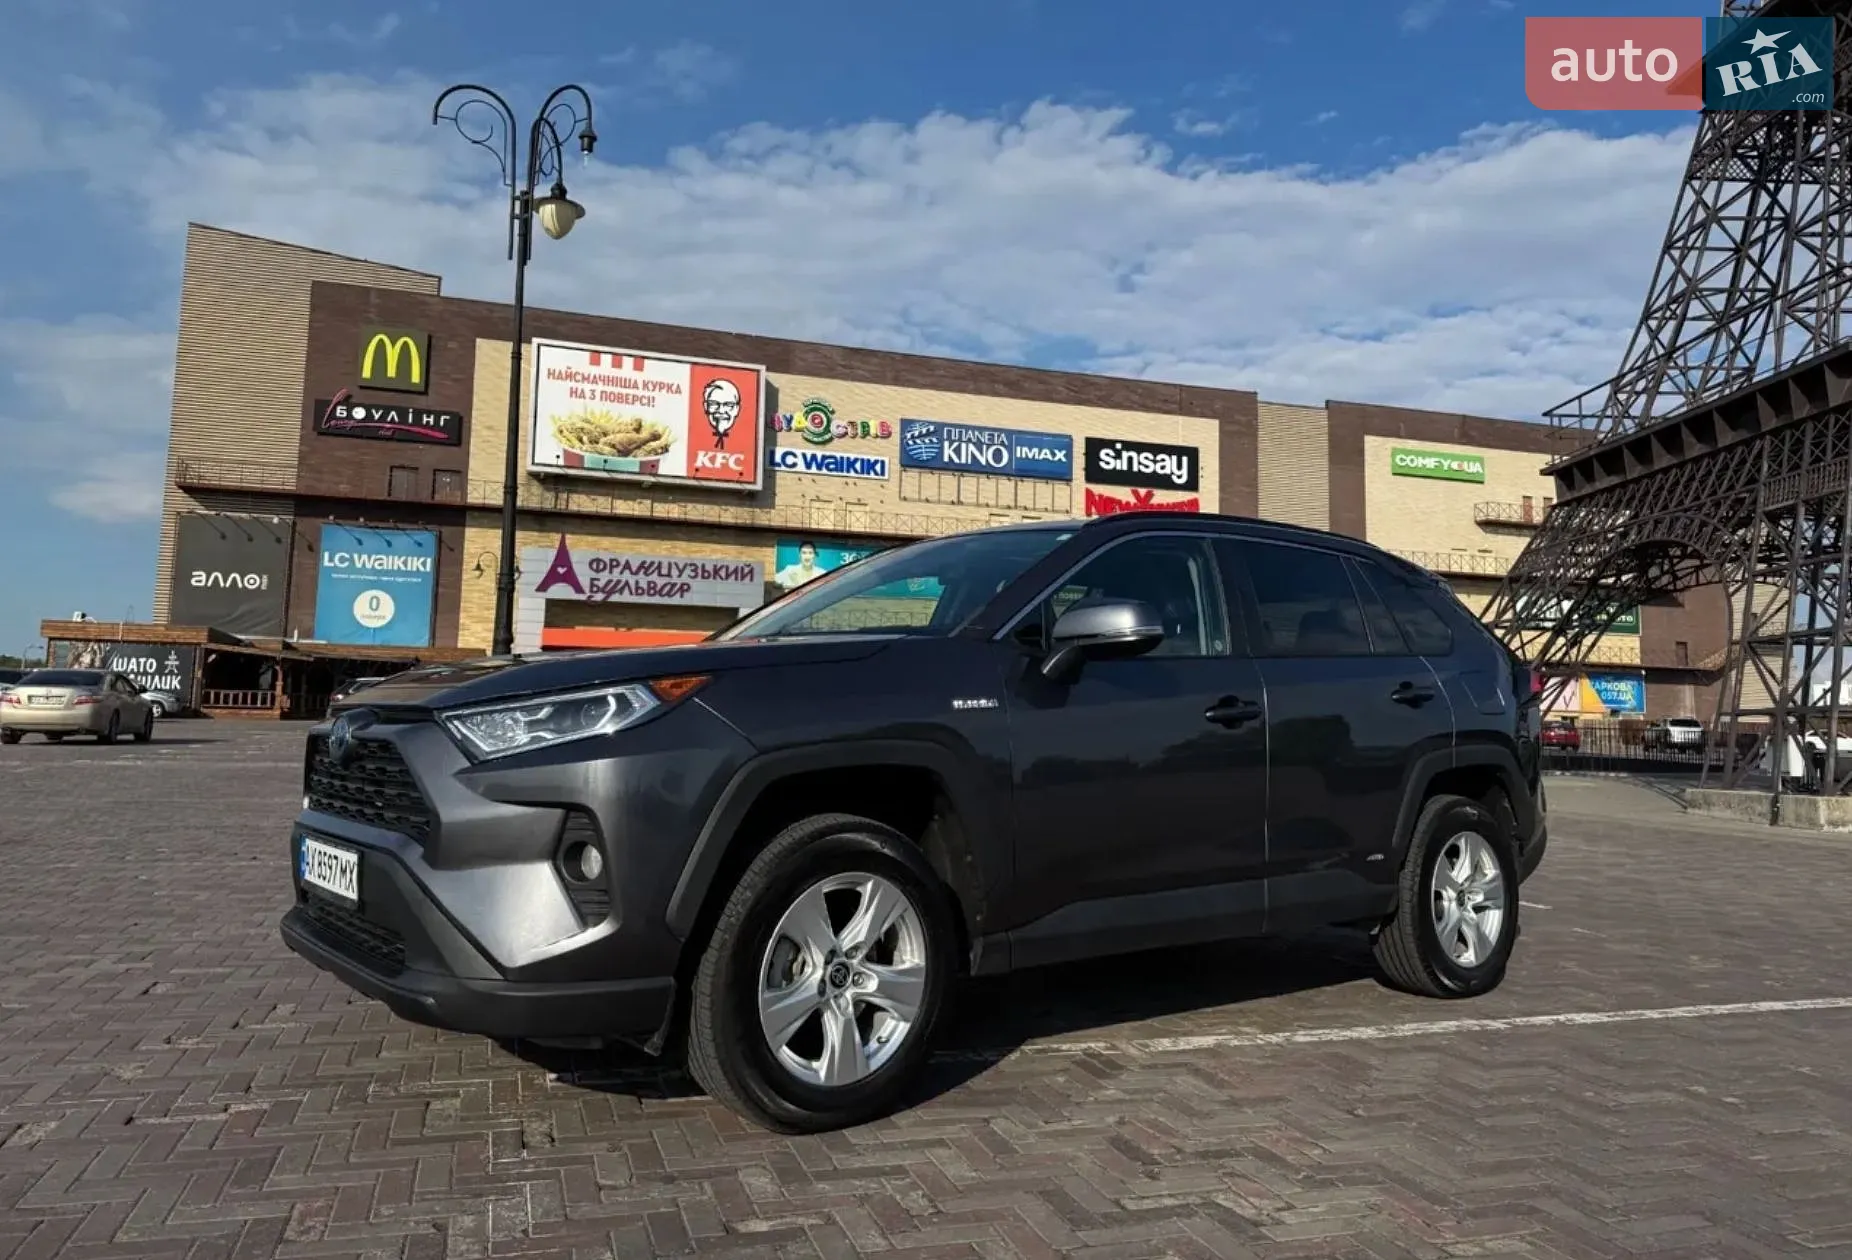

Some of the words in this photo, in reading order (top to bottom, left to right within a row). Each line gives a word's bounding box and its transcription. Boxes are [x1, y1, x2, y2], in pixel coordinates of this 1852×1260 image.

[547, 366, 640, 391] НАЙСМАЧНІША
[642, 378, 682, 395] КУРКА
[569, 386, 588, 399] НА
[590, 387, 597, 400] 3
[600, 391, 656, 408] ПОВЕРСІ!
[695, 451, 744, 471] KFC
[769, 449, 798, 469] LC
[943, 441, 1009, 467] KINO
[1016, 446, 1067, 462] IMAX
[1099, 442, 1188, 484] sinsay
[324, 551, 349, 568] LC
[113, 657, 157, 673] ШАТО
